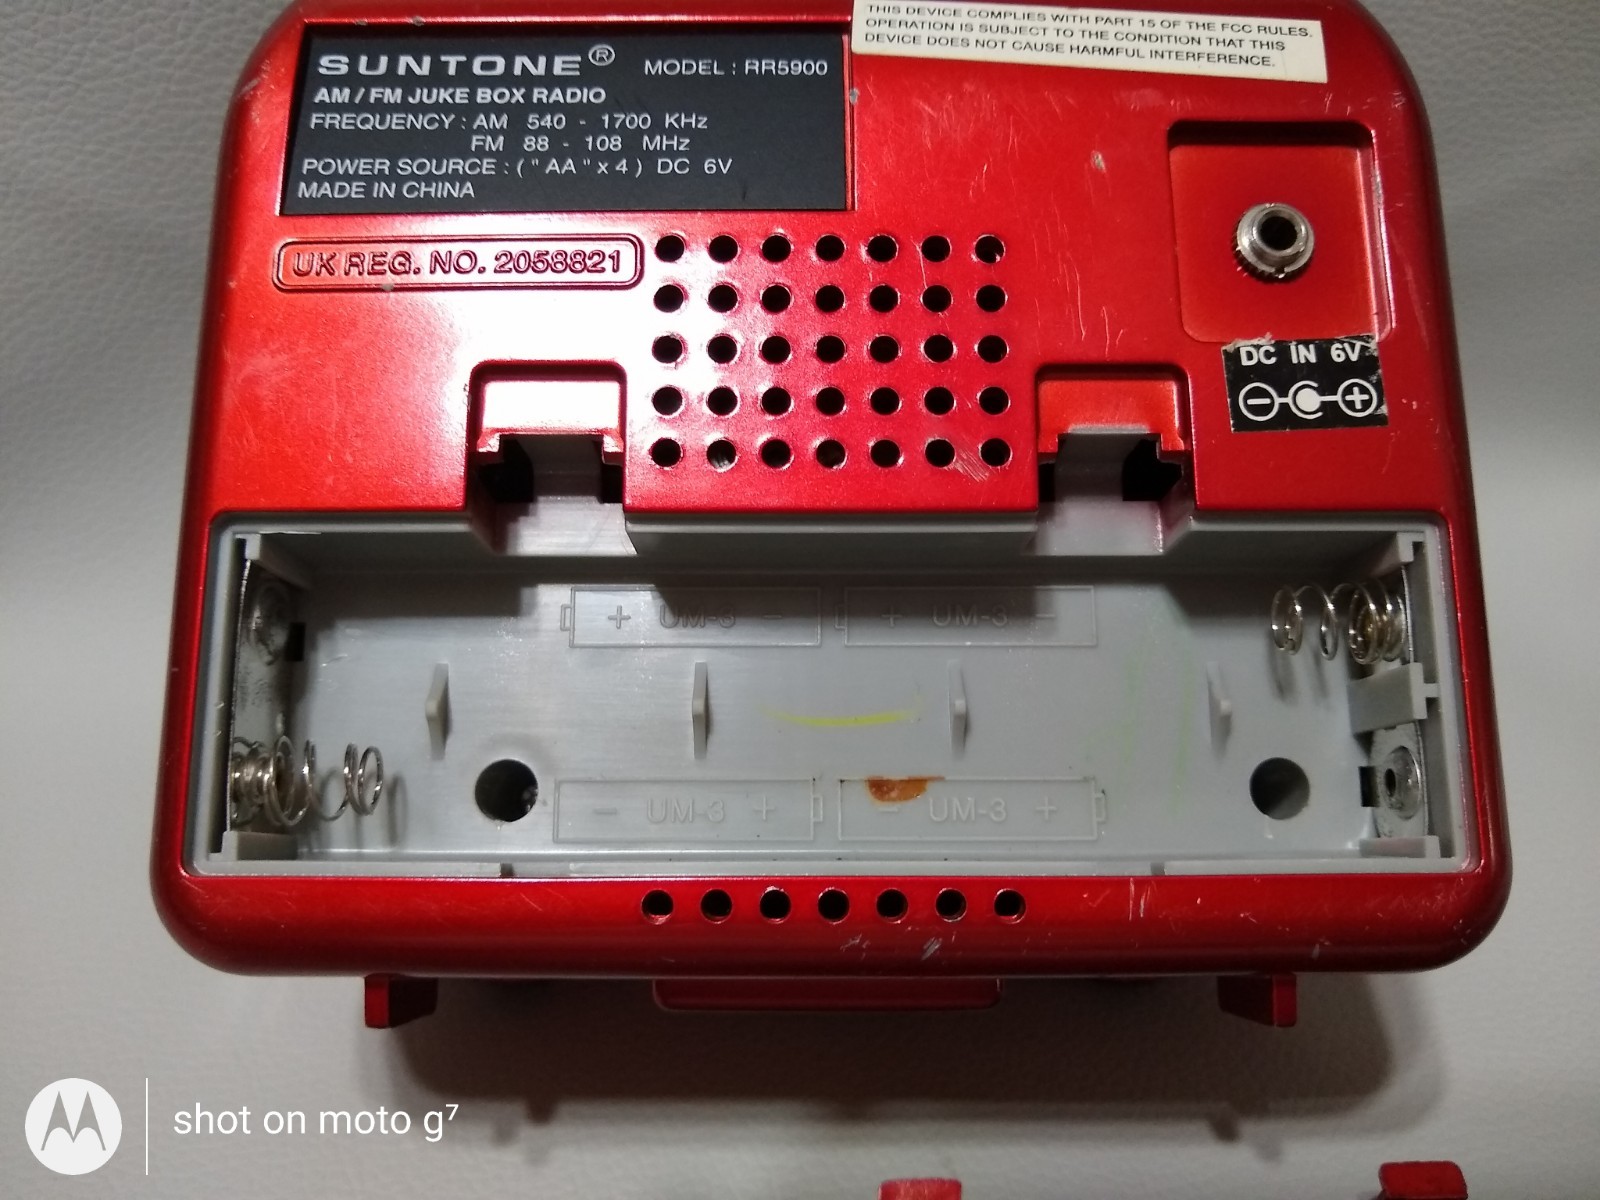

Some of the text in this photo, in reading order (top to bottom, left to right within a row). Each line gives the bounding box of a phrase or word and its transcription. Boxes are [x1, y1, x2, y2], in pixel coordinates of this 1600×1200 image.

[866, 4, 1313, 38] THIS DEVICE COMPLIES WITH PART 15 OF THE FCC RULES.
[866, 18, 1286, 51] OPERATION IS SUBJECT TO THE CONDITION THAT THIS
[864, 32, 1276, 68] DEVICE DOES NOT CAUSE HARMFUL INTERFERENCE.
[744, 59, 828, 76] RR5900
[407, 87, 470, 104] JUKE
[476, 87, 526, 104] BOX
[532, 87, 606, 104] RADIO
[472, 113, 508, 130] AM
[527, 113, 566, 130] 540
[601, 113, 651, 130] 1700
[664, 113, 708, 130] KHz
[471, 135, 505, 151] FM
[523, 135, 549, 151] 88
[585, 135, 622, 151] 108
[642, 135, 691, 151] MHz
[302, 158, 390, 175] POWER
[657, 158, 690, 174] DC
[703, 158, 733, 174] 6V
[297, 182, 475, 199] MADE IN CHINA
[293, 249, 622, 276] UK REG. NO. 2058821
[1239, 342, 1362, 366] DC IN 6V
[659, 603, 736, 629] UM-3
[931, 603, 1009, 628] UM-3
[646, 799, 726, 823] UM-3
[929, 798, 1008, 823] UM-3
